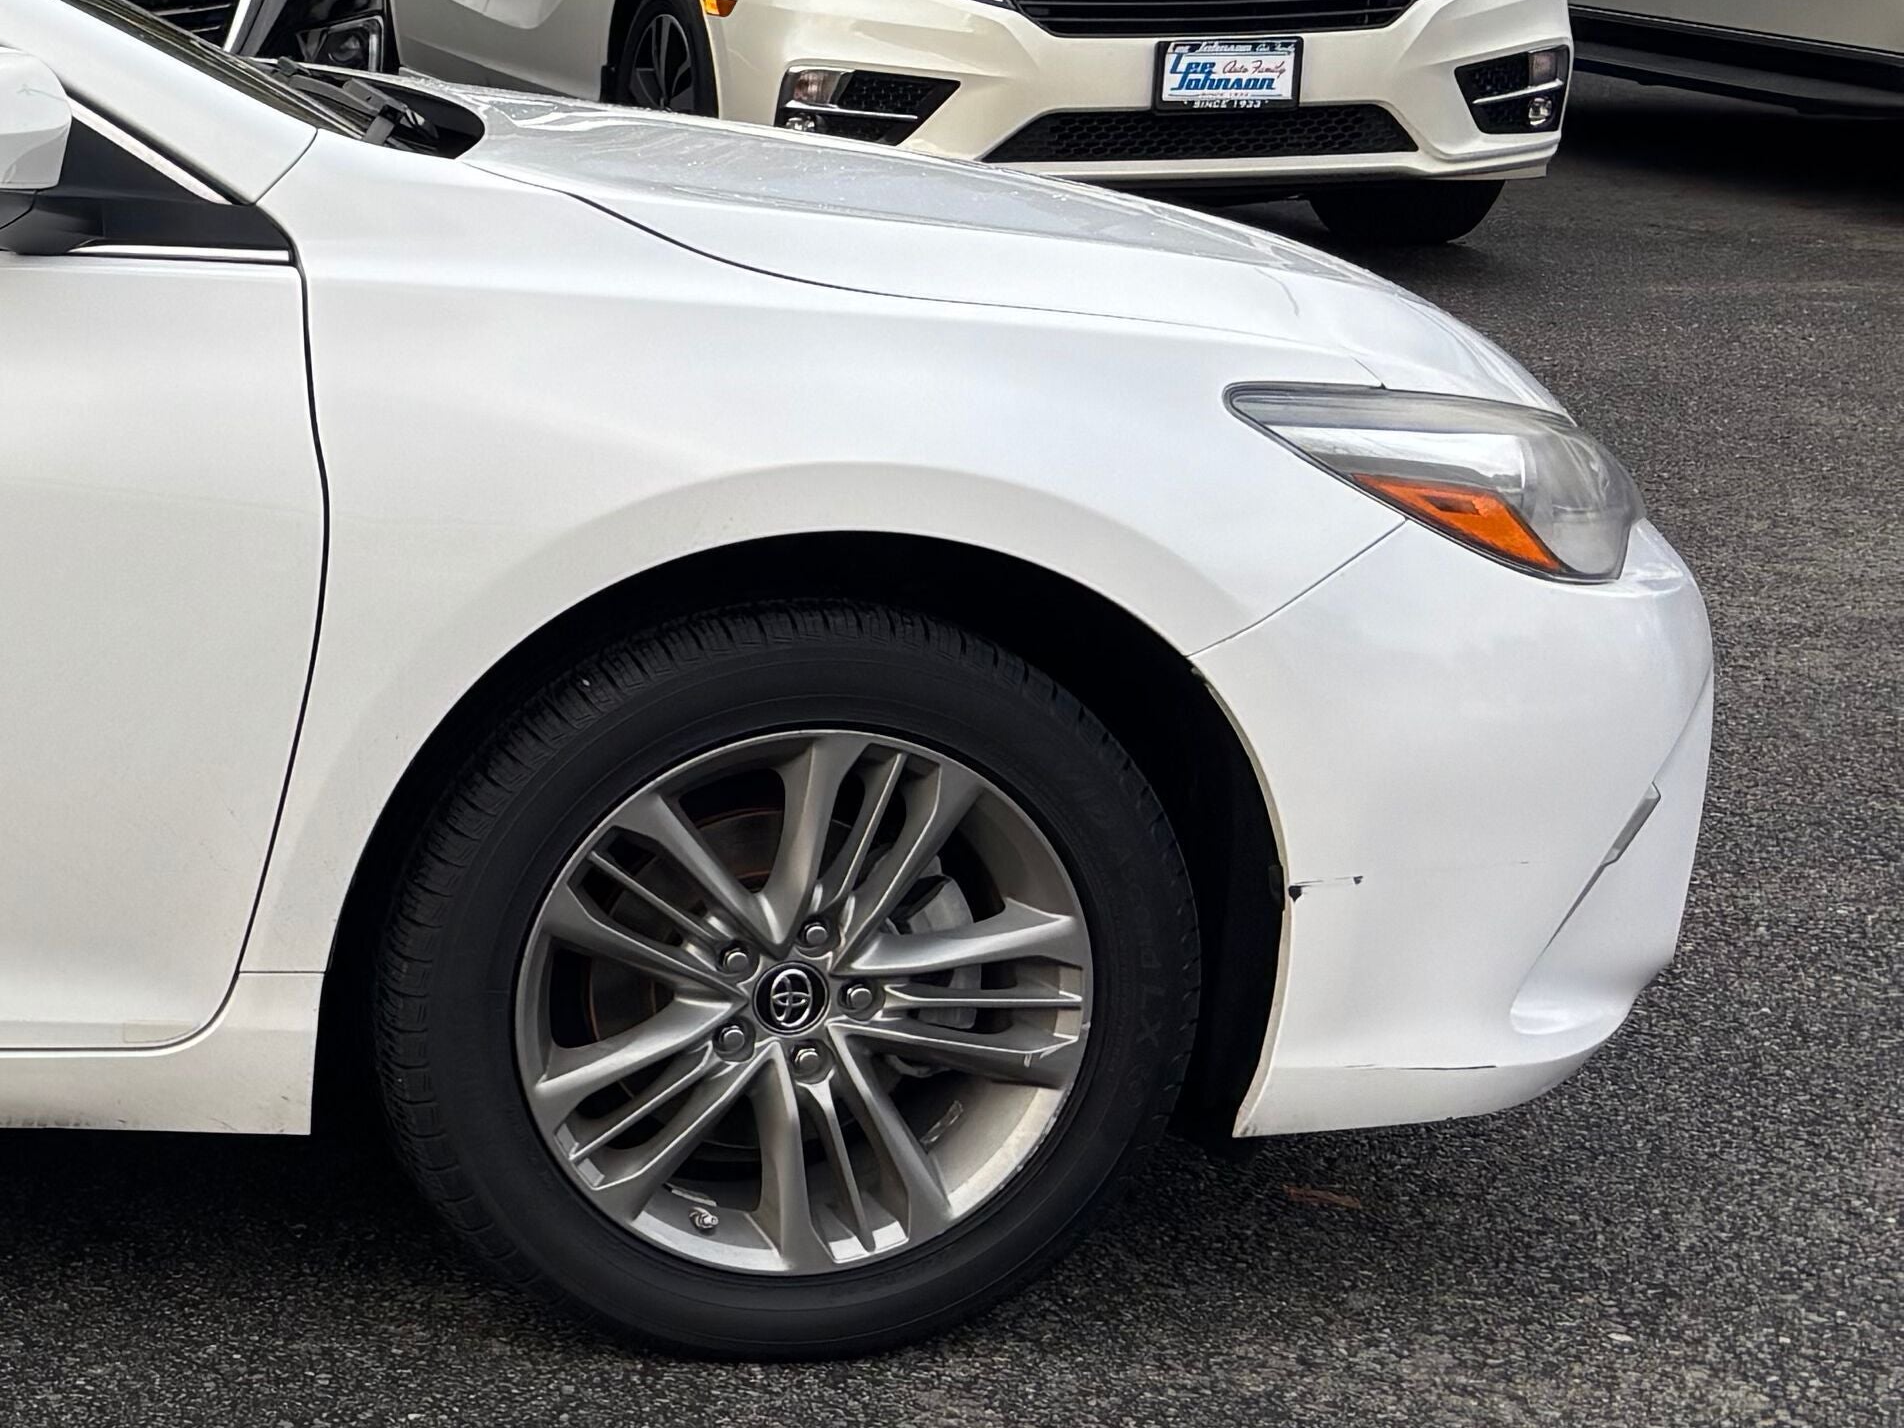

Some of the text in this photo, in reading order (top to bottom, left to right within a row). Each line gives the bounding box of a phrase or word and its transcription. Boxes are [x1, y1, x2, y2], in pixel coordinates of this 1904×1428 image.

[1170, 53, 1287, 78] Lee Auto Family
[1170, 72, 1276, 91] Johnson
[1193, 99, 1228, 108] SINCE
